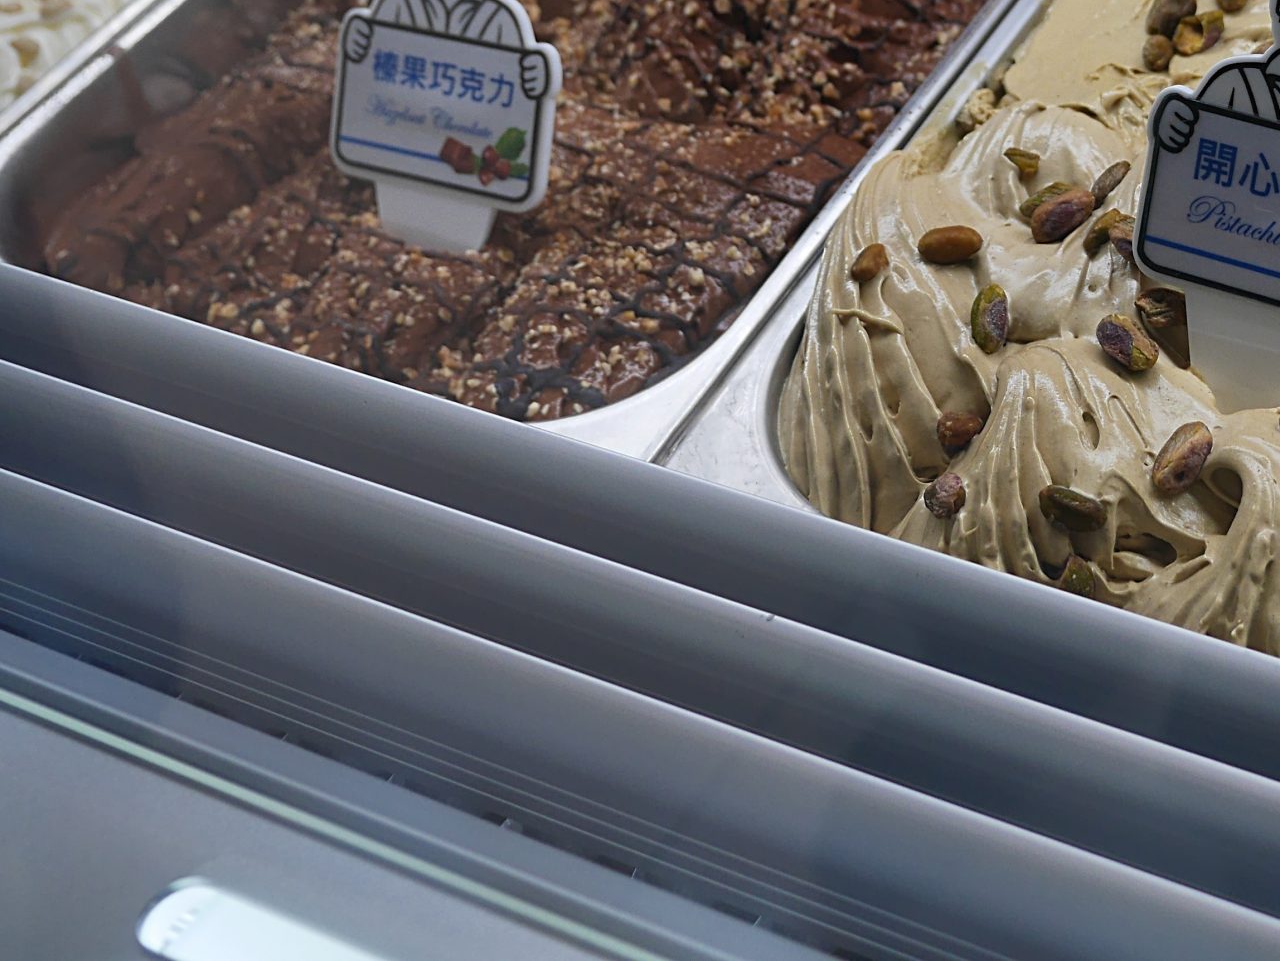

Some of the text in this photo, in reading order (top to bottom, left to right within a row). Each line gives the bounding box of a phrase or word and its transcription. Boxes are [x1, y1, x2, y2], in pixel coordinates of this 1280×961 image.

[373, 49, 514, 108] 榛果巧克力
